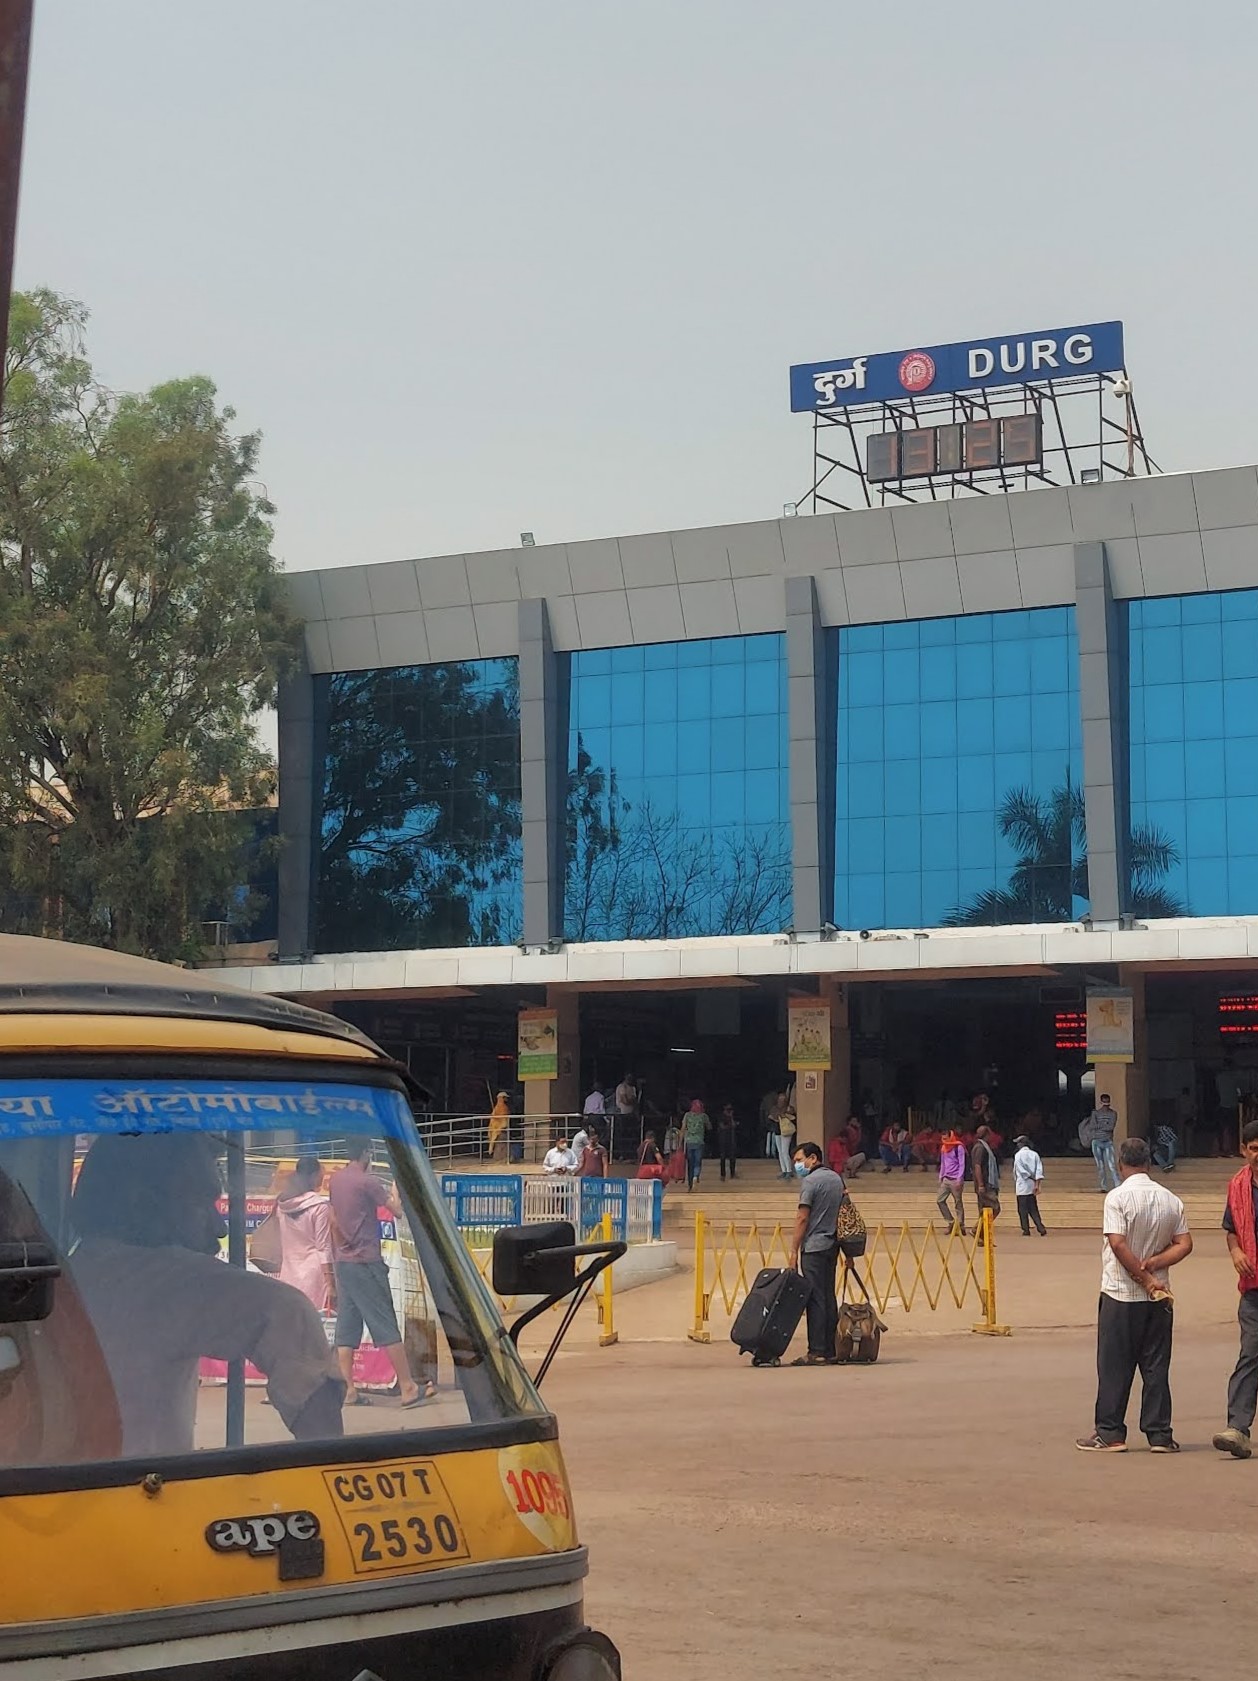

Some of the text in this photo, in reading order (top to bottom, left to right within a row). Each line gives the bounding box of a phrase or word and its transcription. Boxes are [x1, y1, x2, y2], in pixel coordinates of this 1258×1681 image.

[968, 333, 1094, 379] DURG
[812, 357, 868, 406] दुर्ग
[214, 1513, 317, 1552] ape
[354, 1513, 459, 1563] 2530
